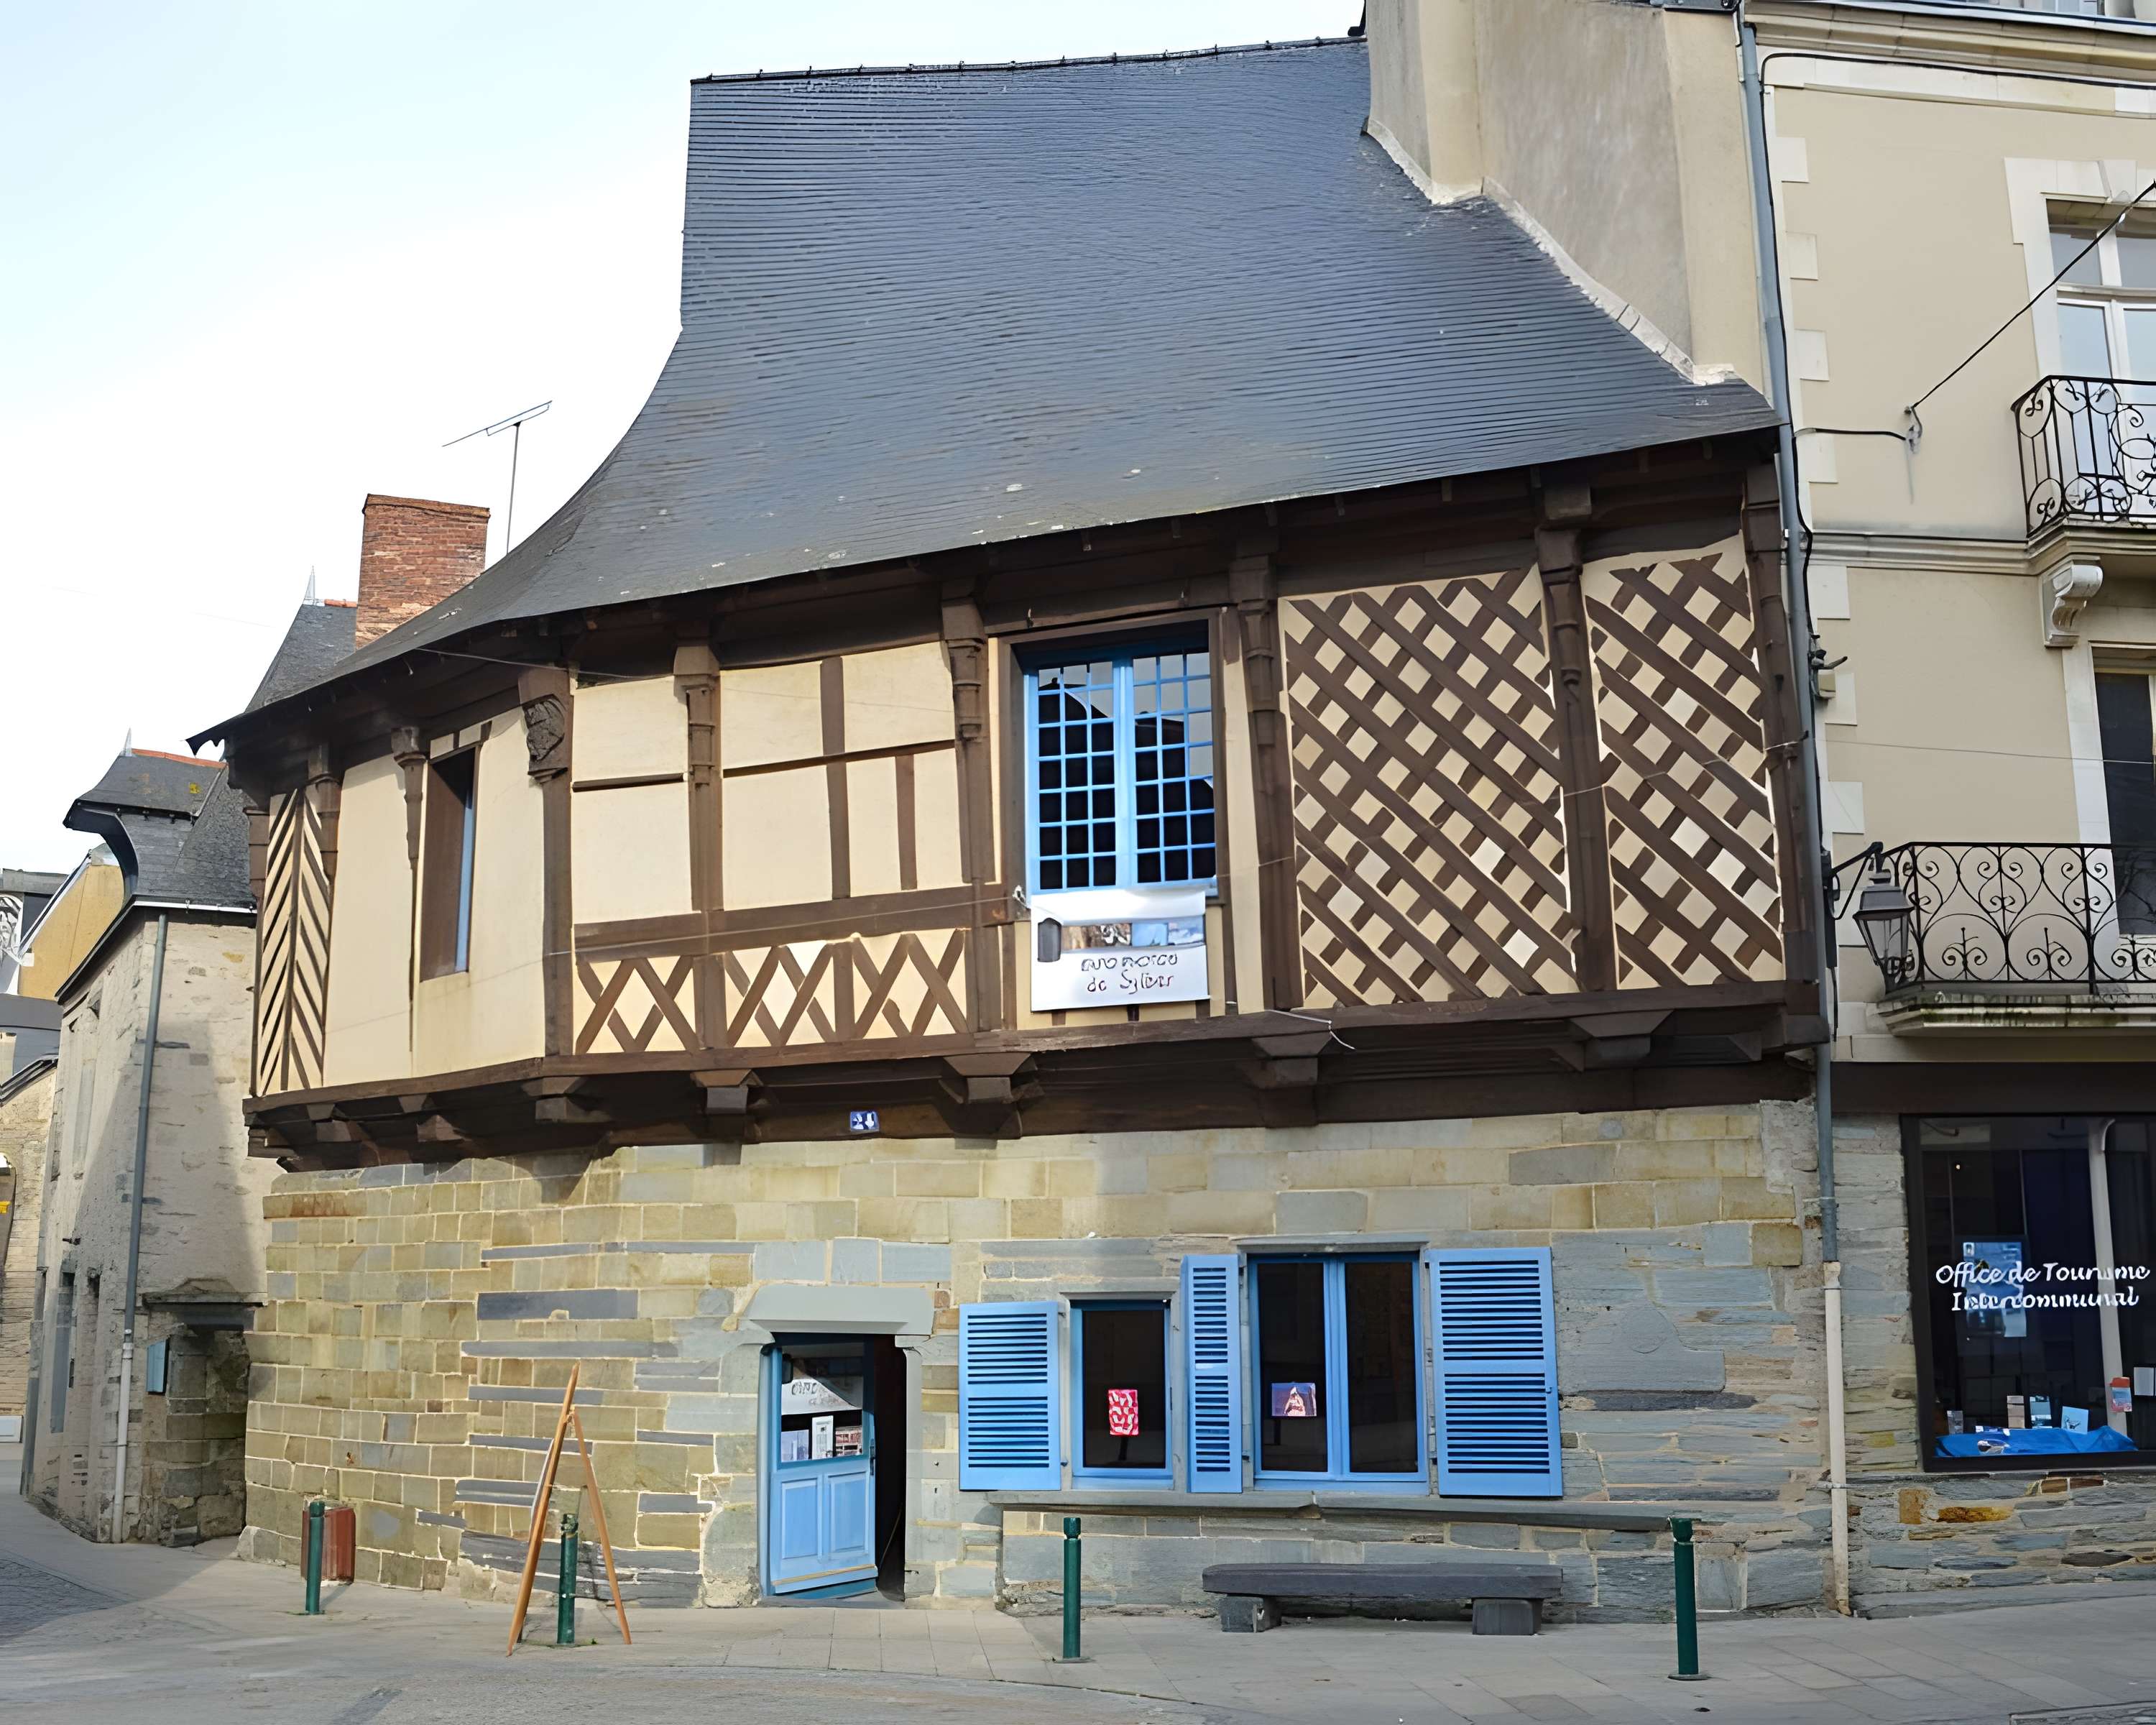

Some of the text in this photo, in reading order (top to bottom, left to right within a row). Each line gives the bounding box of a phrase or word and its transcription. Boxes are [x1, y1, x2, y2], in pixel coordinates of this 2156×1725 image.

[1935, 1260, 2151, 1288] Office de Tourisme
